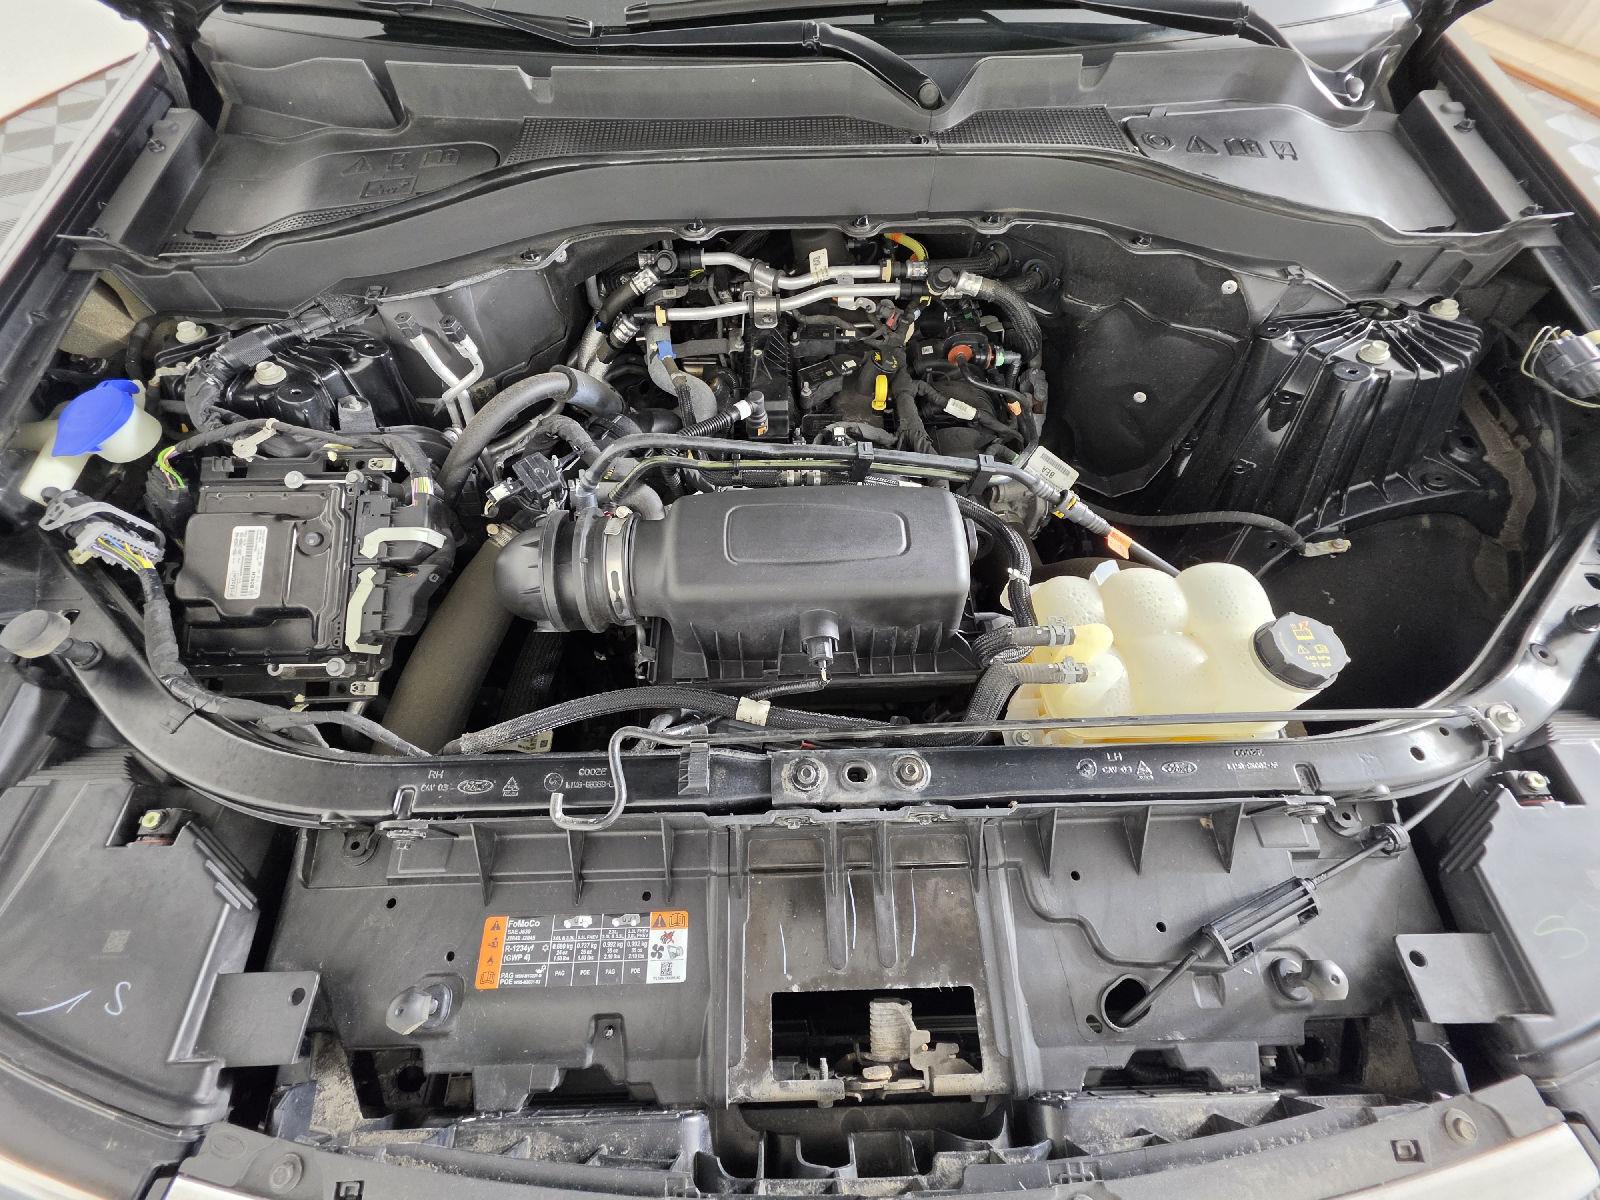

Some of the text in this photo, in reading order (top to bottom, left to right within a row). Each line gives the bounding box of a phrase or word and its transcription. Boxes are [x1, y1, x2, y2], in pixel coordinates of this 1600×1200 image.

[1106, 752, 1123, 762] LH
[428, 769, 444, 779] RH
[508, 919, 541, 928] FoMoCo
[504, 944, 535, 953] R-1234yf
[590, 942, 598, 950] kg
[617, 941, 624, 949] kg
[503, 953, 531, 963] (GWP 4)
